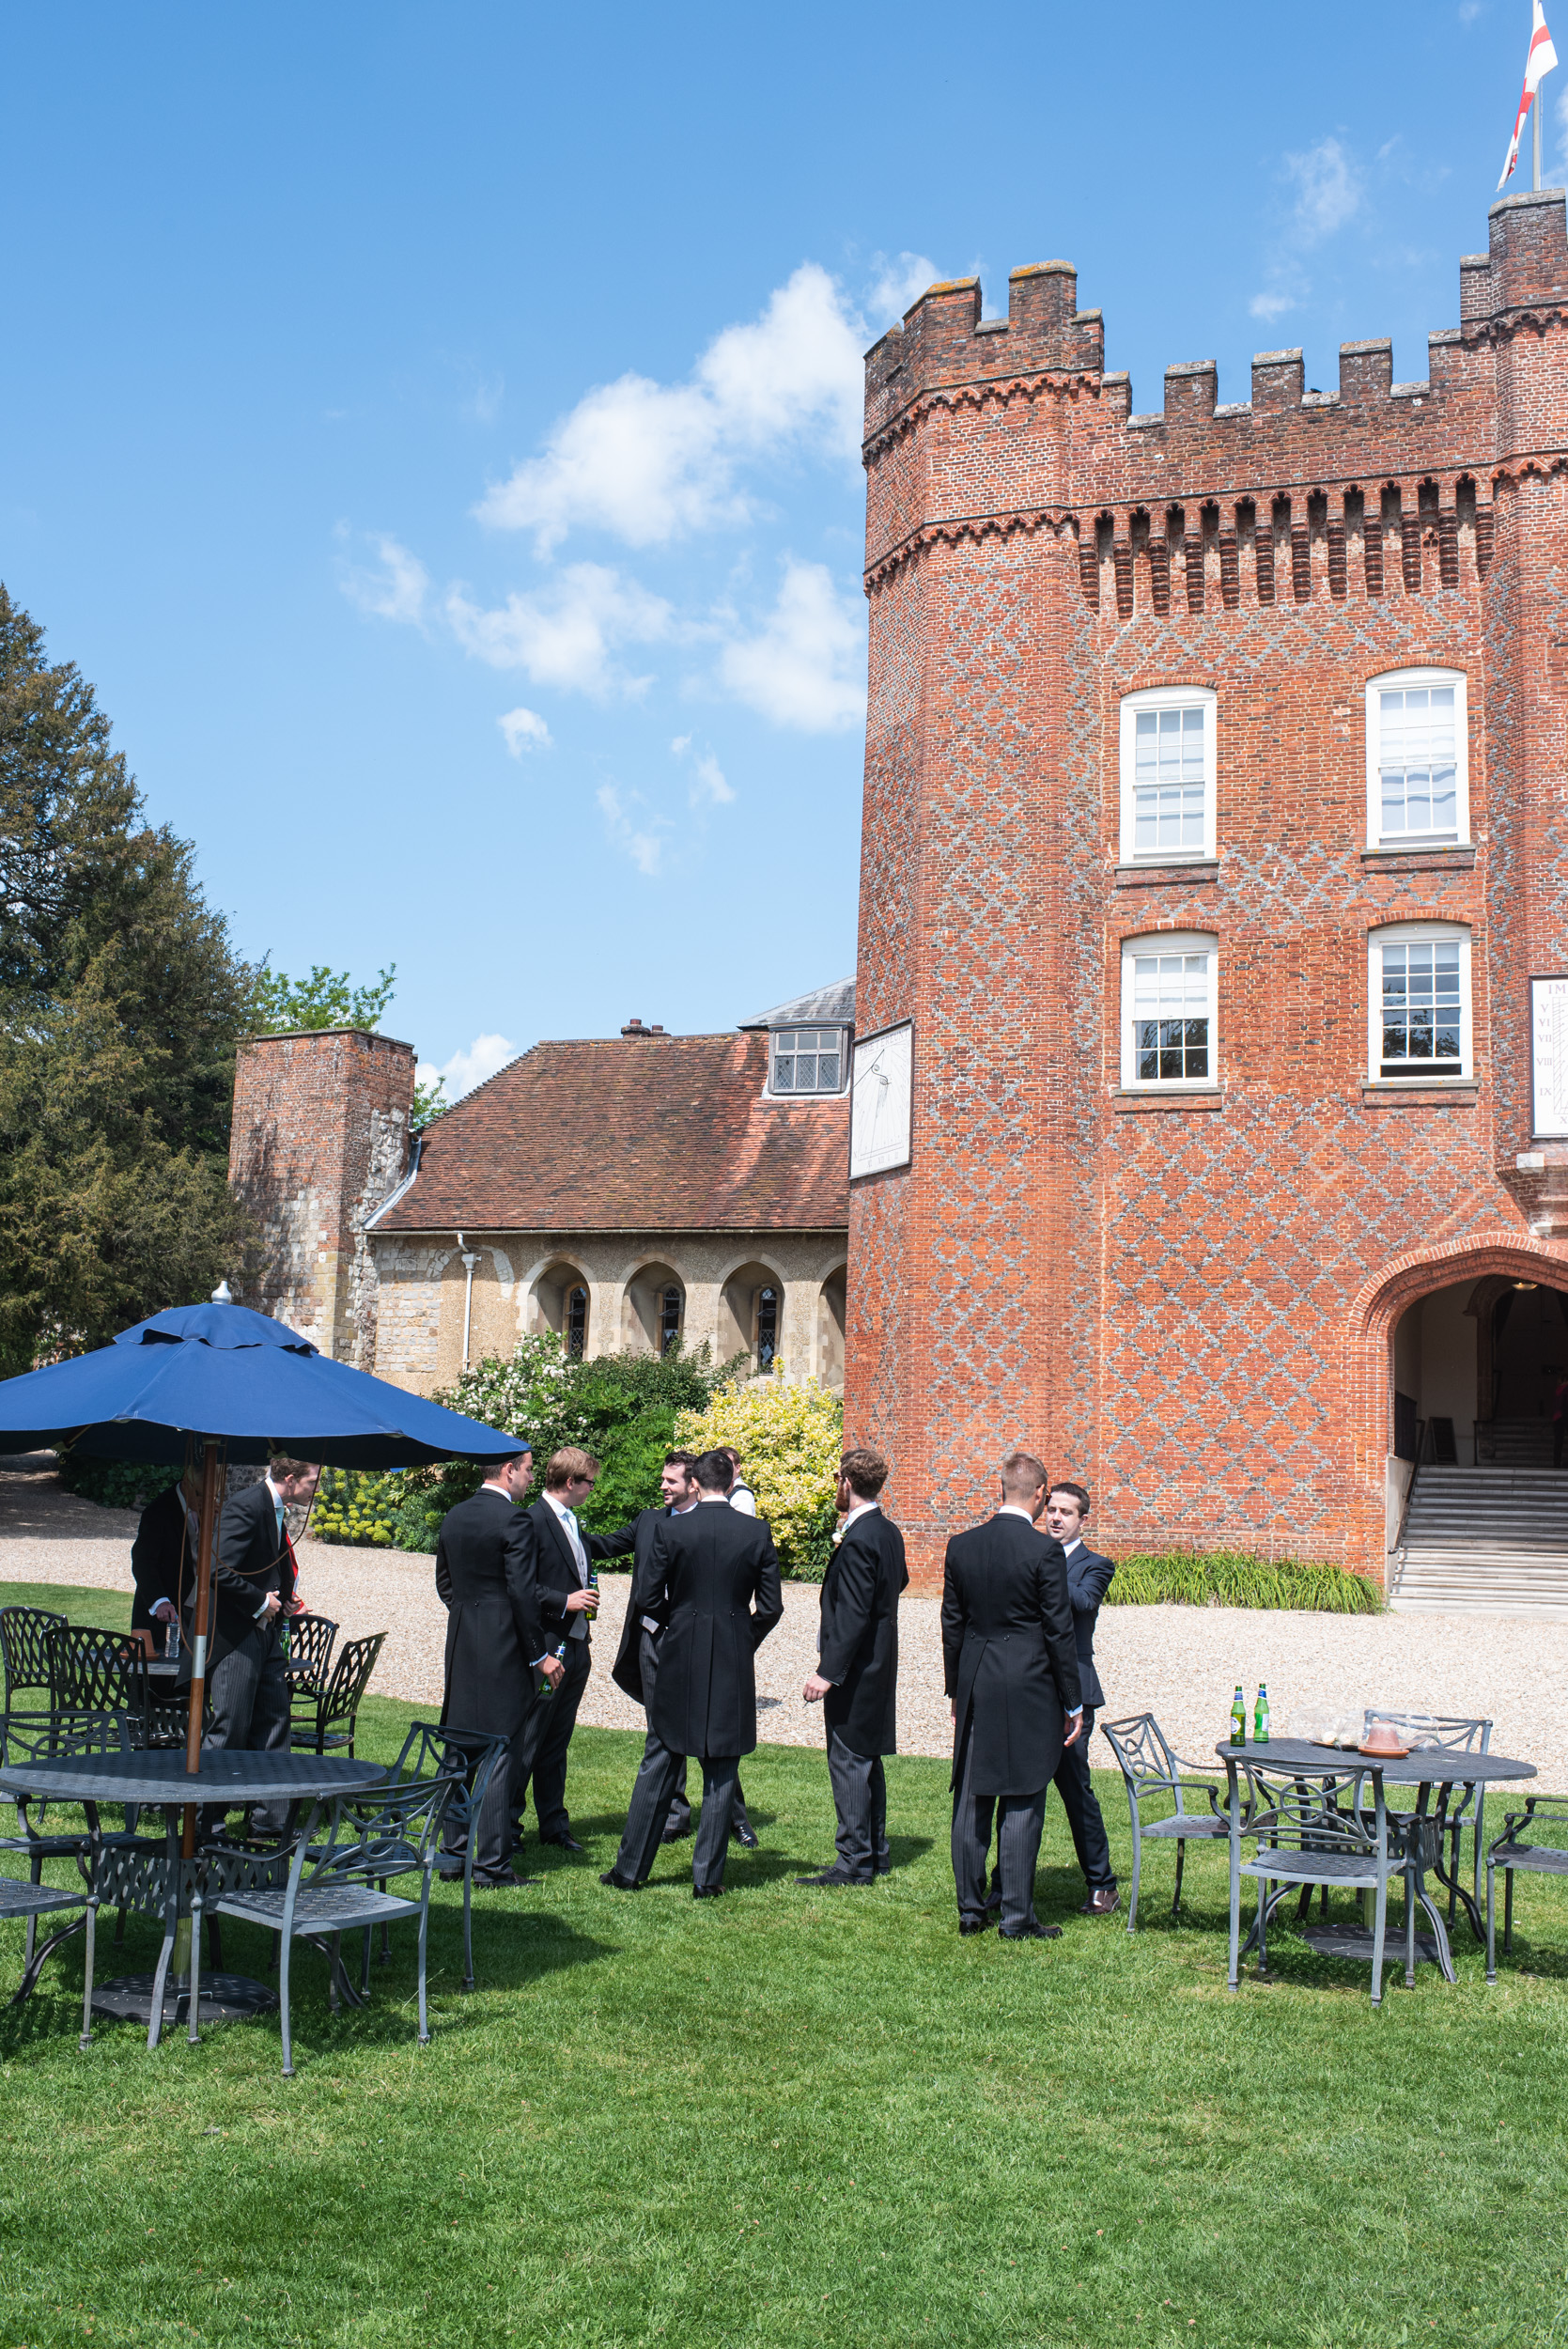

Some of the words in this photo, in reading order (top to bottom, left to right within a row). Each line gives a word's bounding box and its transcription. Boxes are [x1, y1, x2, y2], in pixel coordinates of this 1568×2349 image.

[1541, 1003, 1549, 1013] V
[1539, 1019, 1550, 1027] VI
[1538, 1034, 1552, 1042] VII
[1536, 1057, 1552, 1066] VIII
[1540, 1087, 1552, 1096] IX
